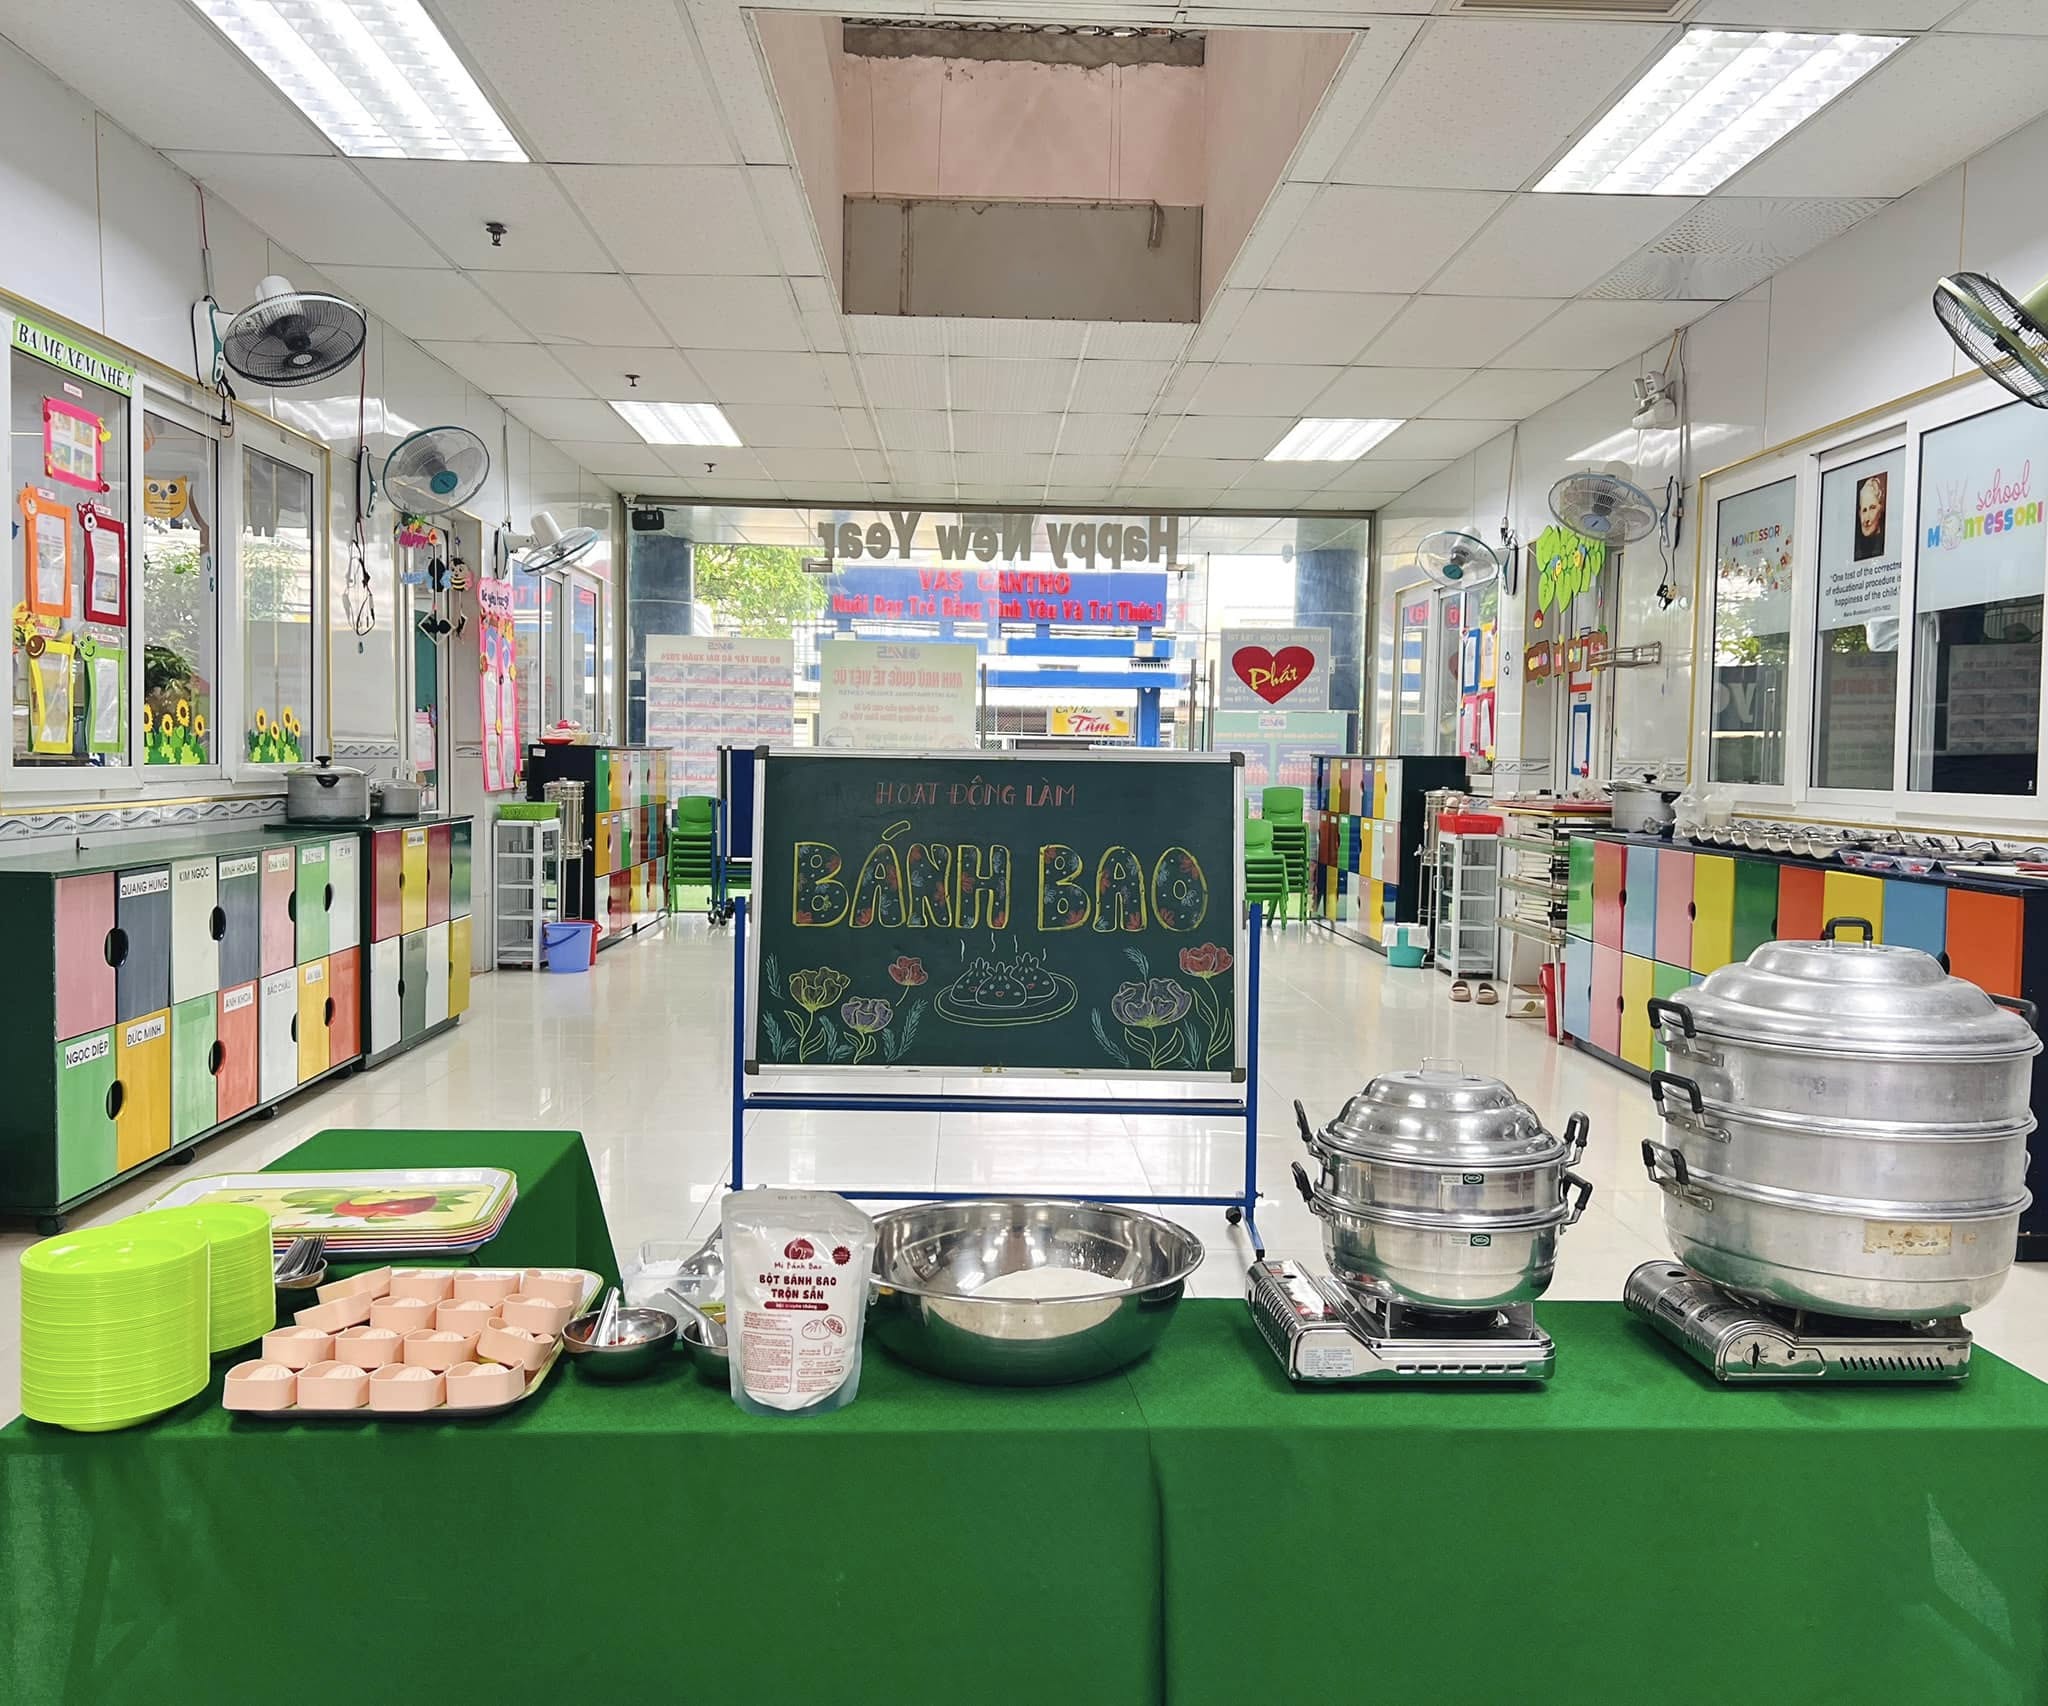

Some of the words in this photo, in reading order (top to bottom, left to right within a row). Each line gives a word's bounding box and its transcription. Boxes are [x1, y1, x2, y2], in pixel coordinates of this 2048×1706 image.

[42, 335, 64, 365] MẸ
[67, 347, 96, 376] XEM
[100, 363, 125, 389] NHÉ
[1975, 459, 2031, 511] school
[918, 568, 965, 592] VAS
[977, 570, 1072, 595] CANTHO
[874, 594, 904, 619] Dạy
[1027, 598, 1057, 620] Yêu
[1062, 598, 1084, 621] Và
[1248, 660, 1299, 691] Phát
[1025, 776, 1075, 807] LÀM
[120, 880, 148, 896] QUANG
[179, 870, 191, 882] KIM
[792, 819, 1011, 929] BÁNH
[1038, 844, 1209, 932] BAO
[66, 1047, 90, 1065] NGỌC
[91, 1040, 108, 1057] DIỆP
[759, 1272, 780, 1287] BỘT
[783, 1273, 812, 1286] BÁNH
[816, 1276, 837, 1286] BAO
[771, 1286, 799, 1300] TRỘN
